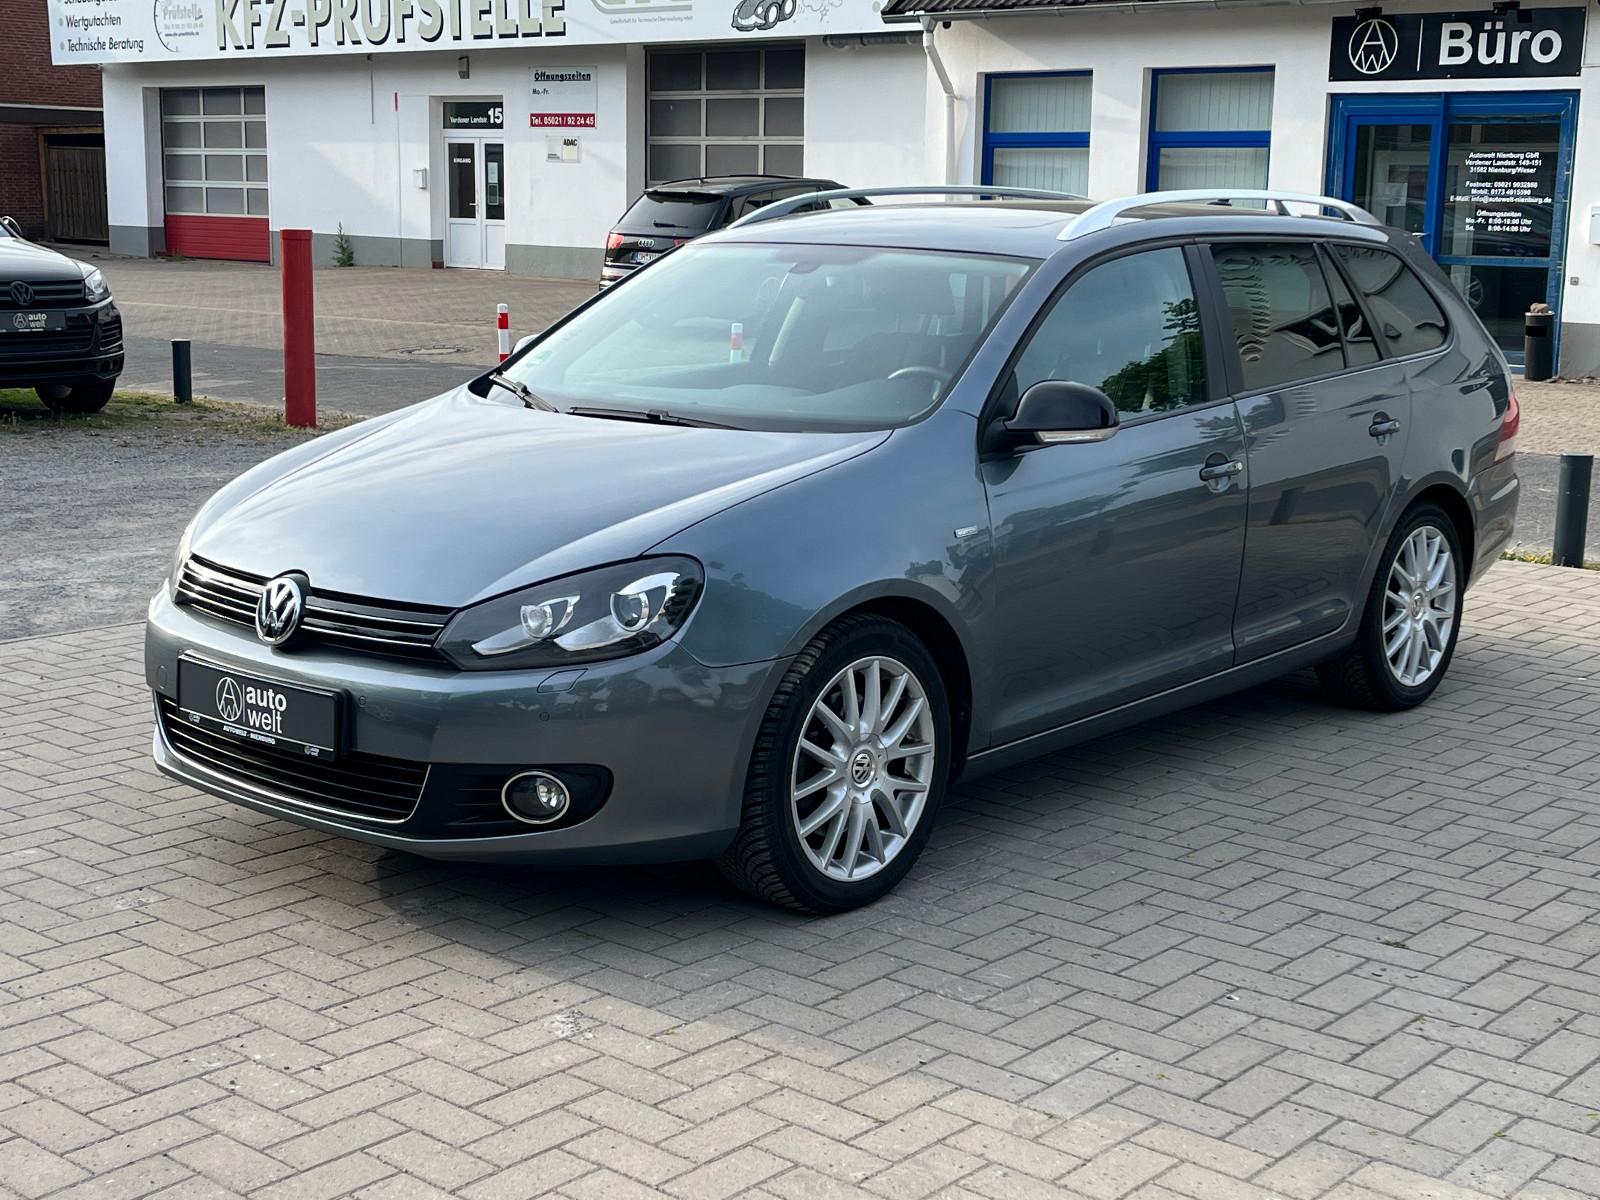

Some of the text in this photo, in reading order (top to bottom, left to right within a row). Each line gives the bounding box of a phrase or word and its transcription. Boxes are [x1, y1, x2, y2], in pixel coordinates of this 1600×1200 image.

[65, 12, 121, 31] Wertgutachten
[68, 36, 144, 53] Technische Beratung
[1439, 21, 1563, 66] Büro
[534, 70, 591, 82] Öffnungszeiten
[532, 116, 543, 125] Tel.
[567, 116, 576, 125] 92
[563, 138, 578, 146] ADAC
[28, 313, 47, 321] auto
[246, 686, 287, 712] auto
[248, 709, 283, 734] welt
